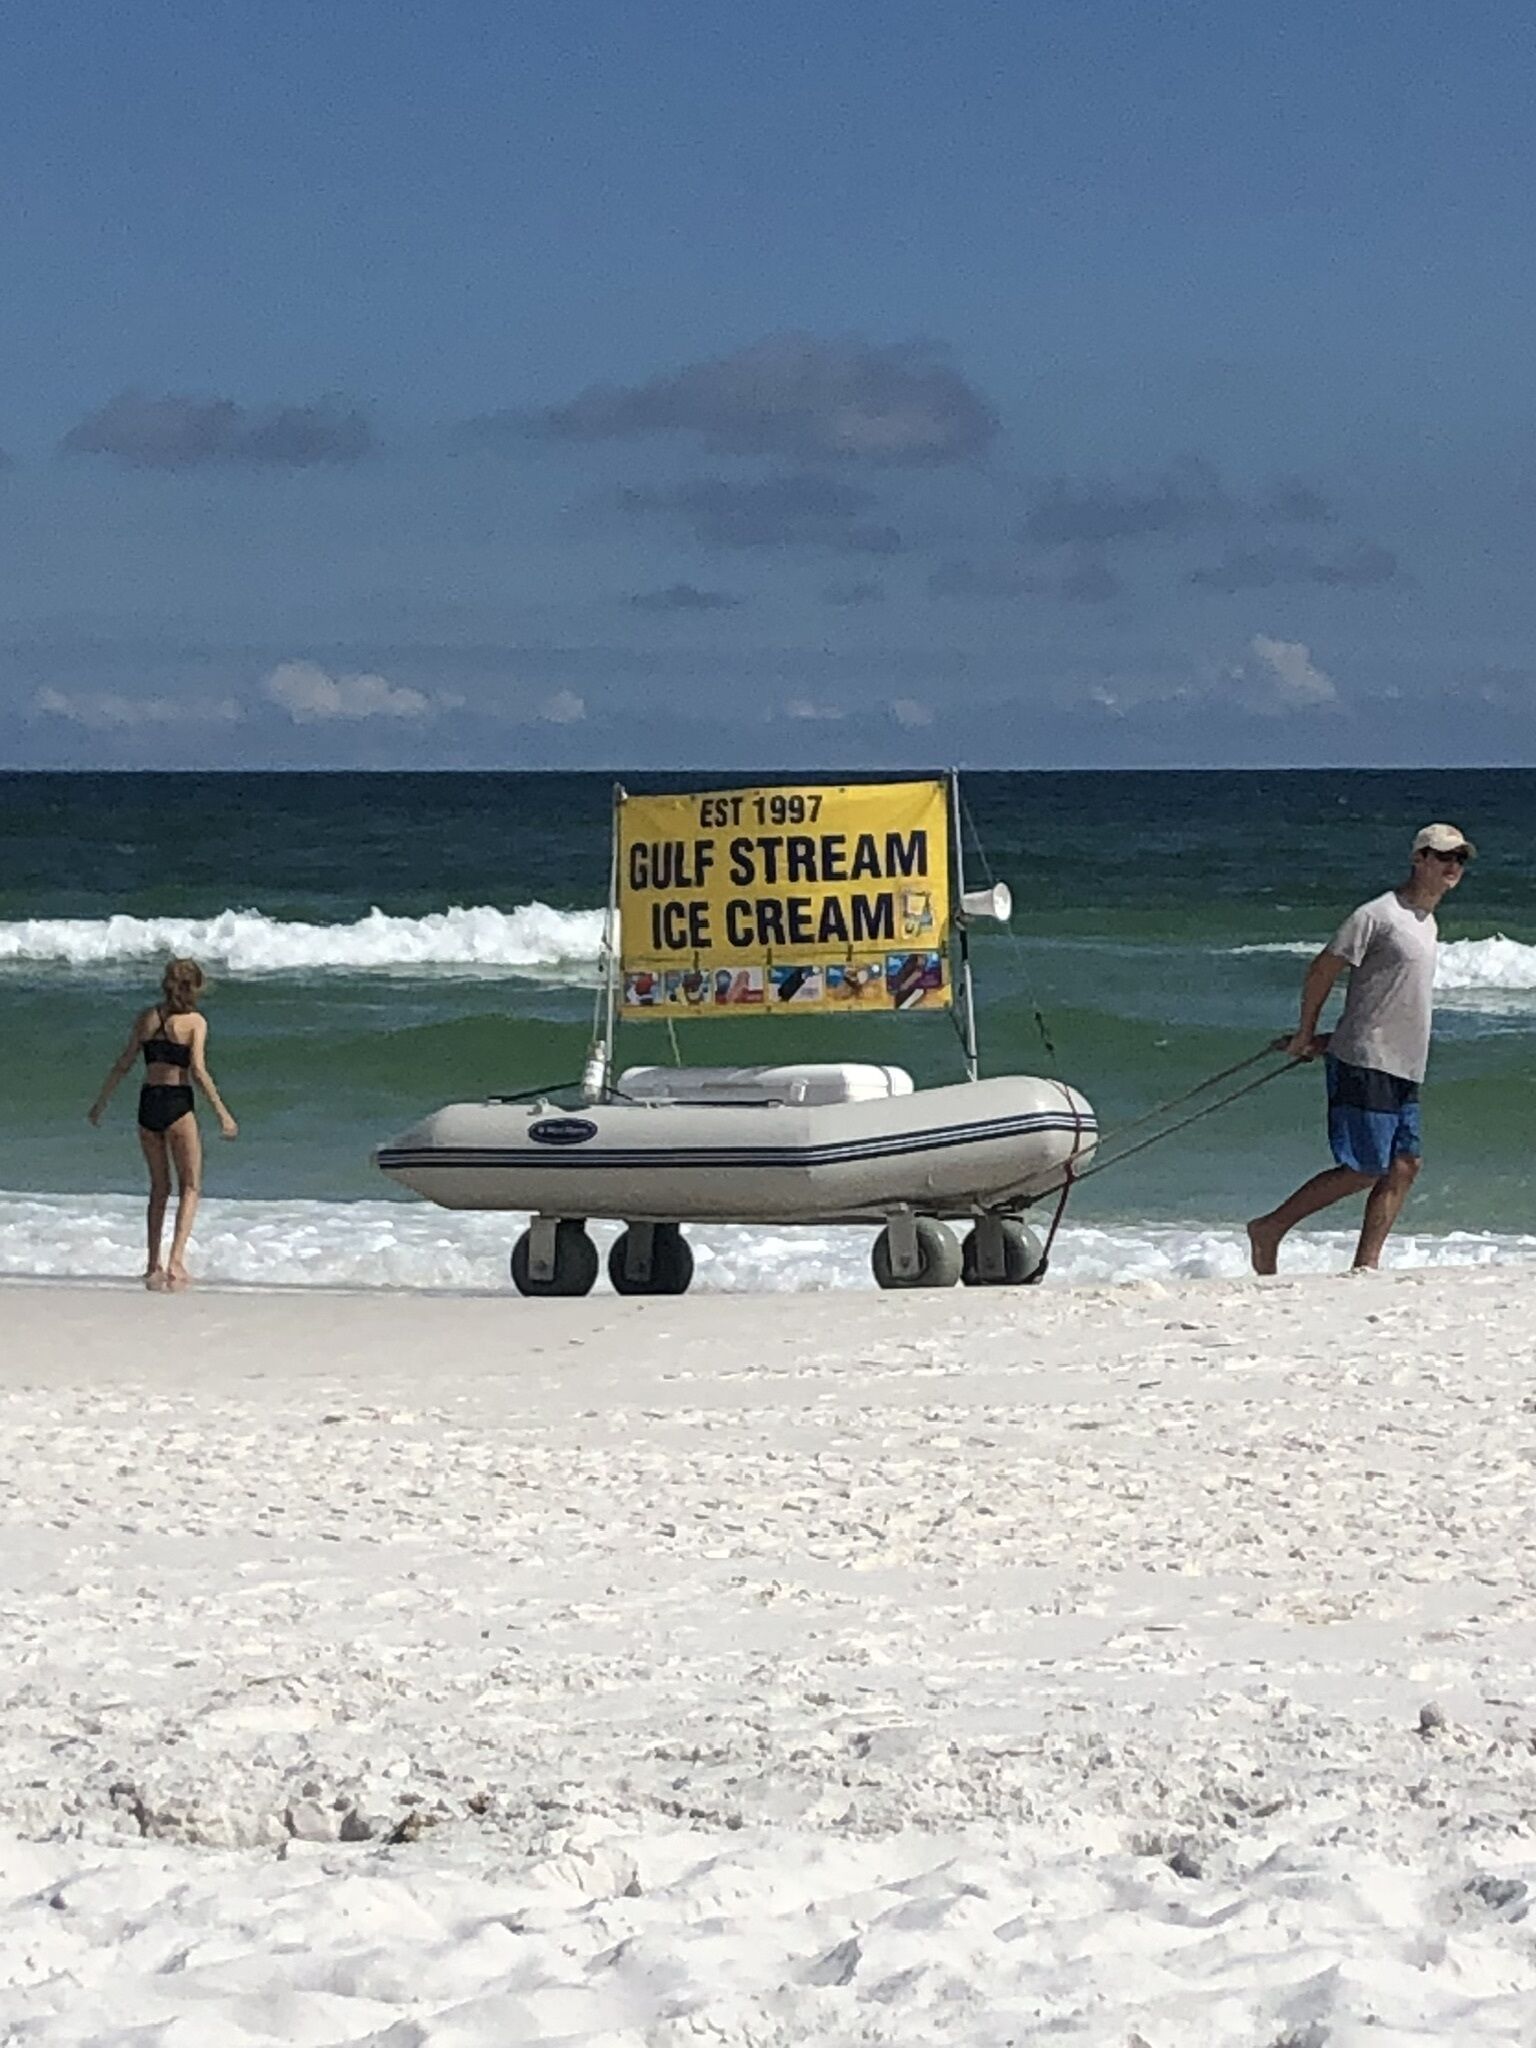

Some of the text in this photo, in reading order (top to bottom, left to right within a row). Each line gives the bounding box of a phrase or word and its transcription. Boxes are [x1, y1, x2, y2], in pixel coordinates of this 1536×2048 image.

[700, 795, 822, 827] EST 1997
[630, 830, 927, 890] GULF STREAM
[652, 893, 894, 949] ICE CREAM
